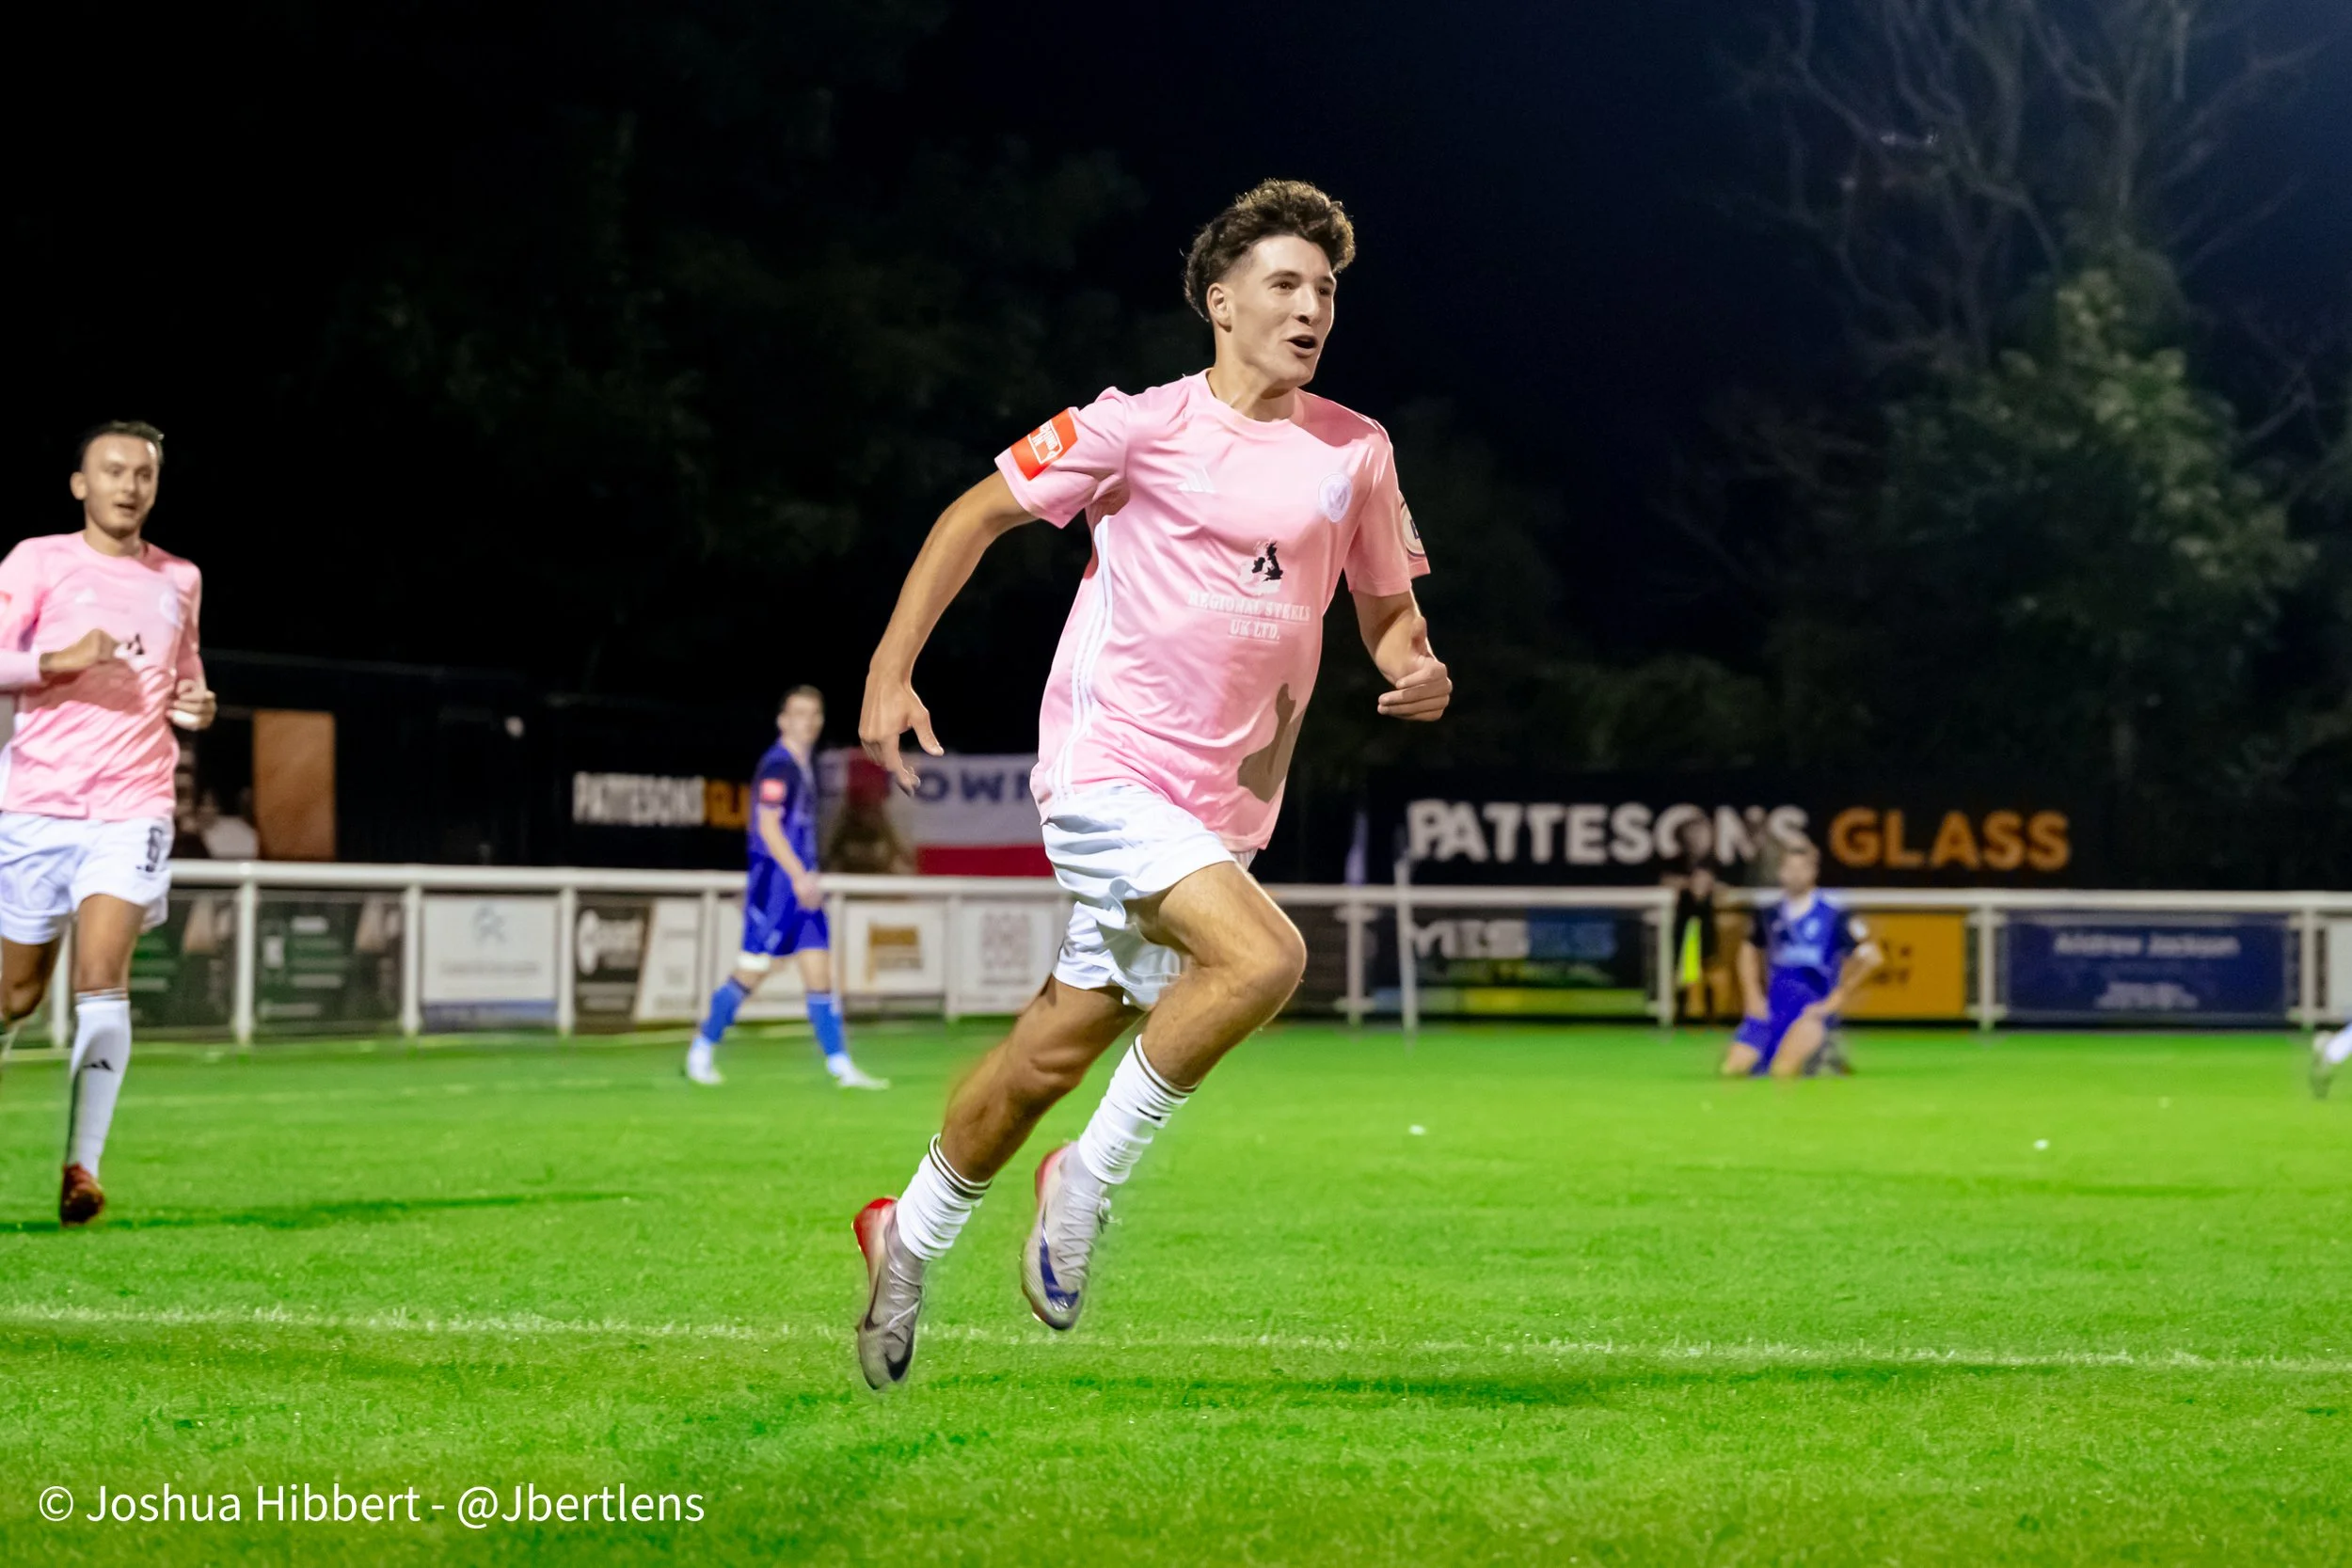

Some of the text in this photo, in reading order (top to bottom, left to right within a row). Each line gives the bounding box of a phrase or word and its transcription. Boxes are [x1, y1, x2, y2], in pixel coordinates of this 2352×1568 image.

[1188, 590, 1262, 615] REGIONAL
[1230, 618, 1252, 637] UK
[1830, 806, 2072, 873] GLASS
